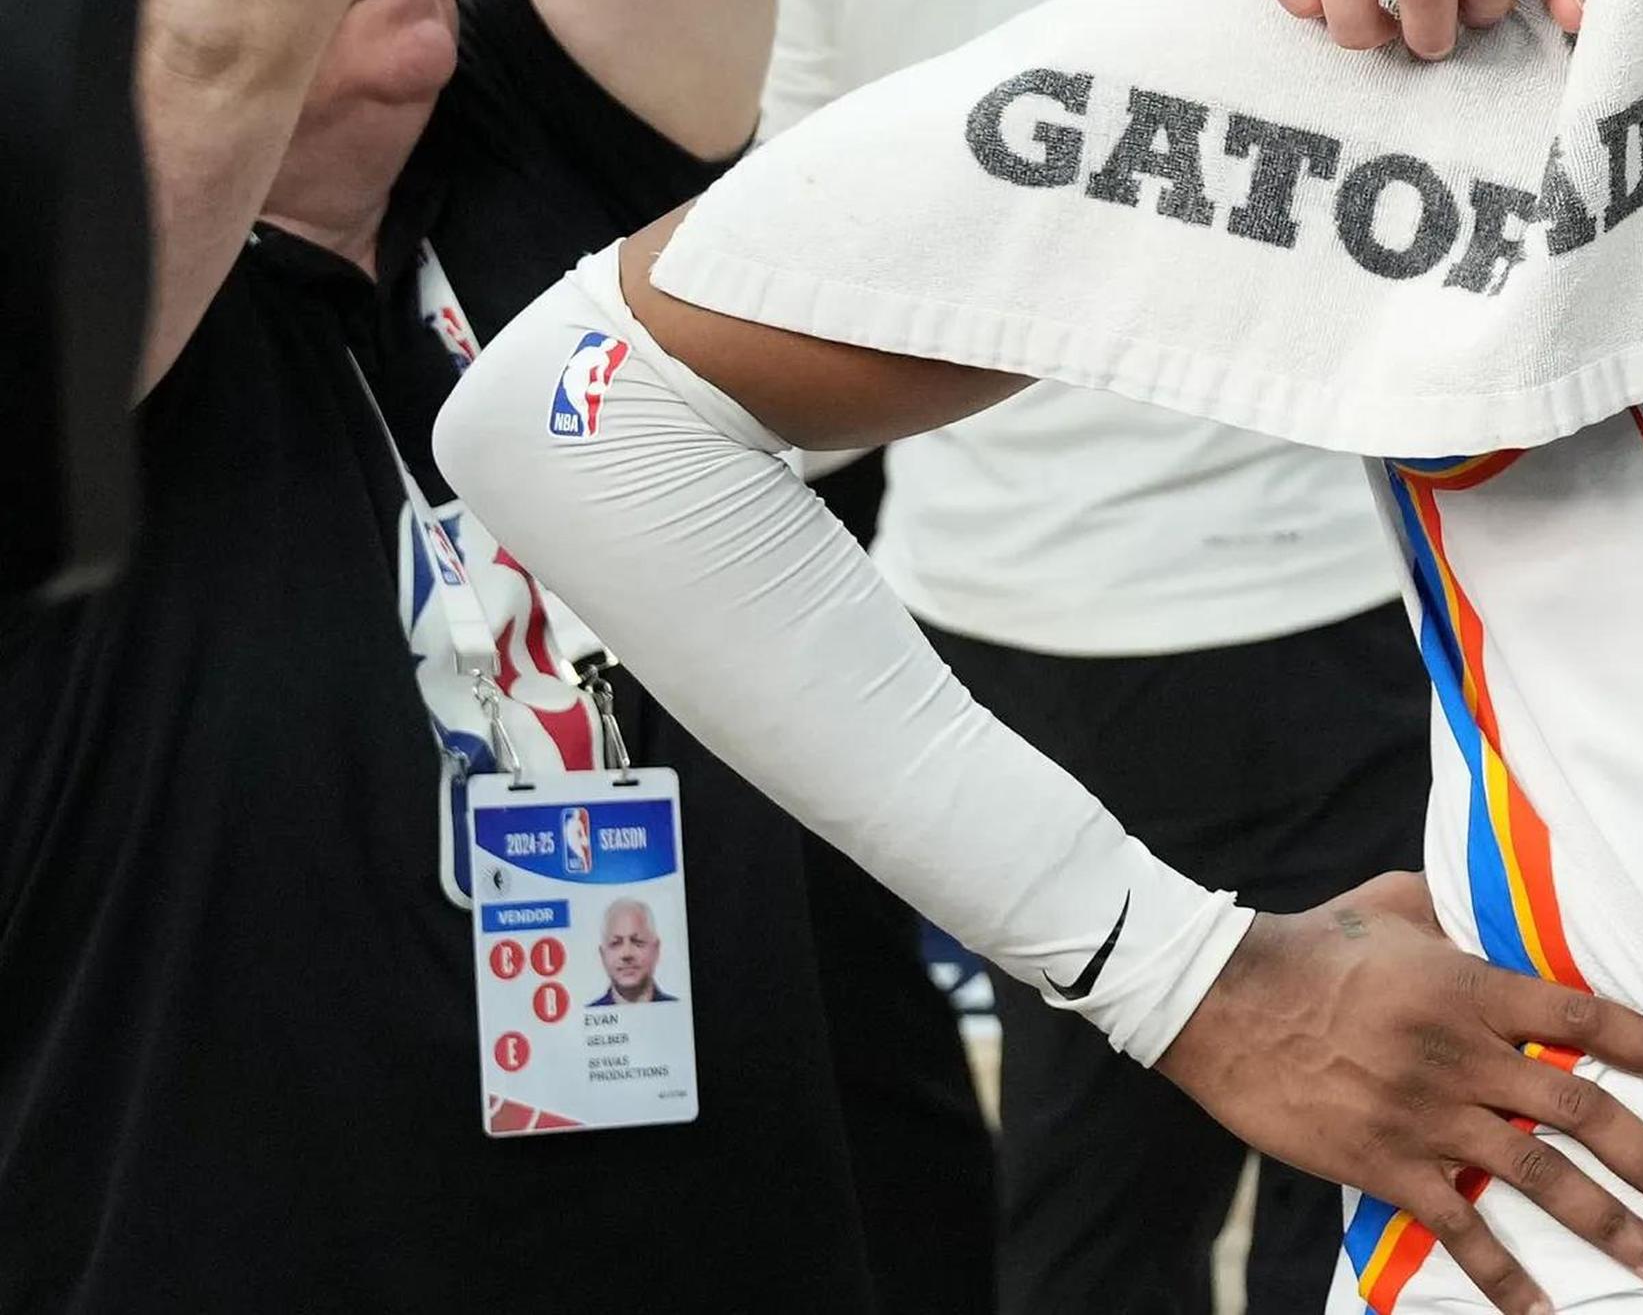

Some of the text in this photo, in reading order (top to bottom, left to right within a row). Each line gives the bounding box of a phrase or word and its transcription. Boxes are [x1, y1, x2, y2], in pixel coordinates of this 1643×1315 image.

[553, 412, 579, 433] NBA
[505, 828, 648, 855] 2024-25 SEASON
[497, 908, 554, 925] VENDOR
[584, 1013, 619, 1026] EVAN
